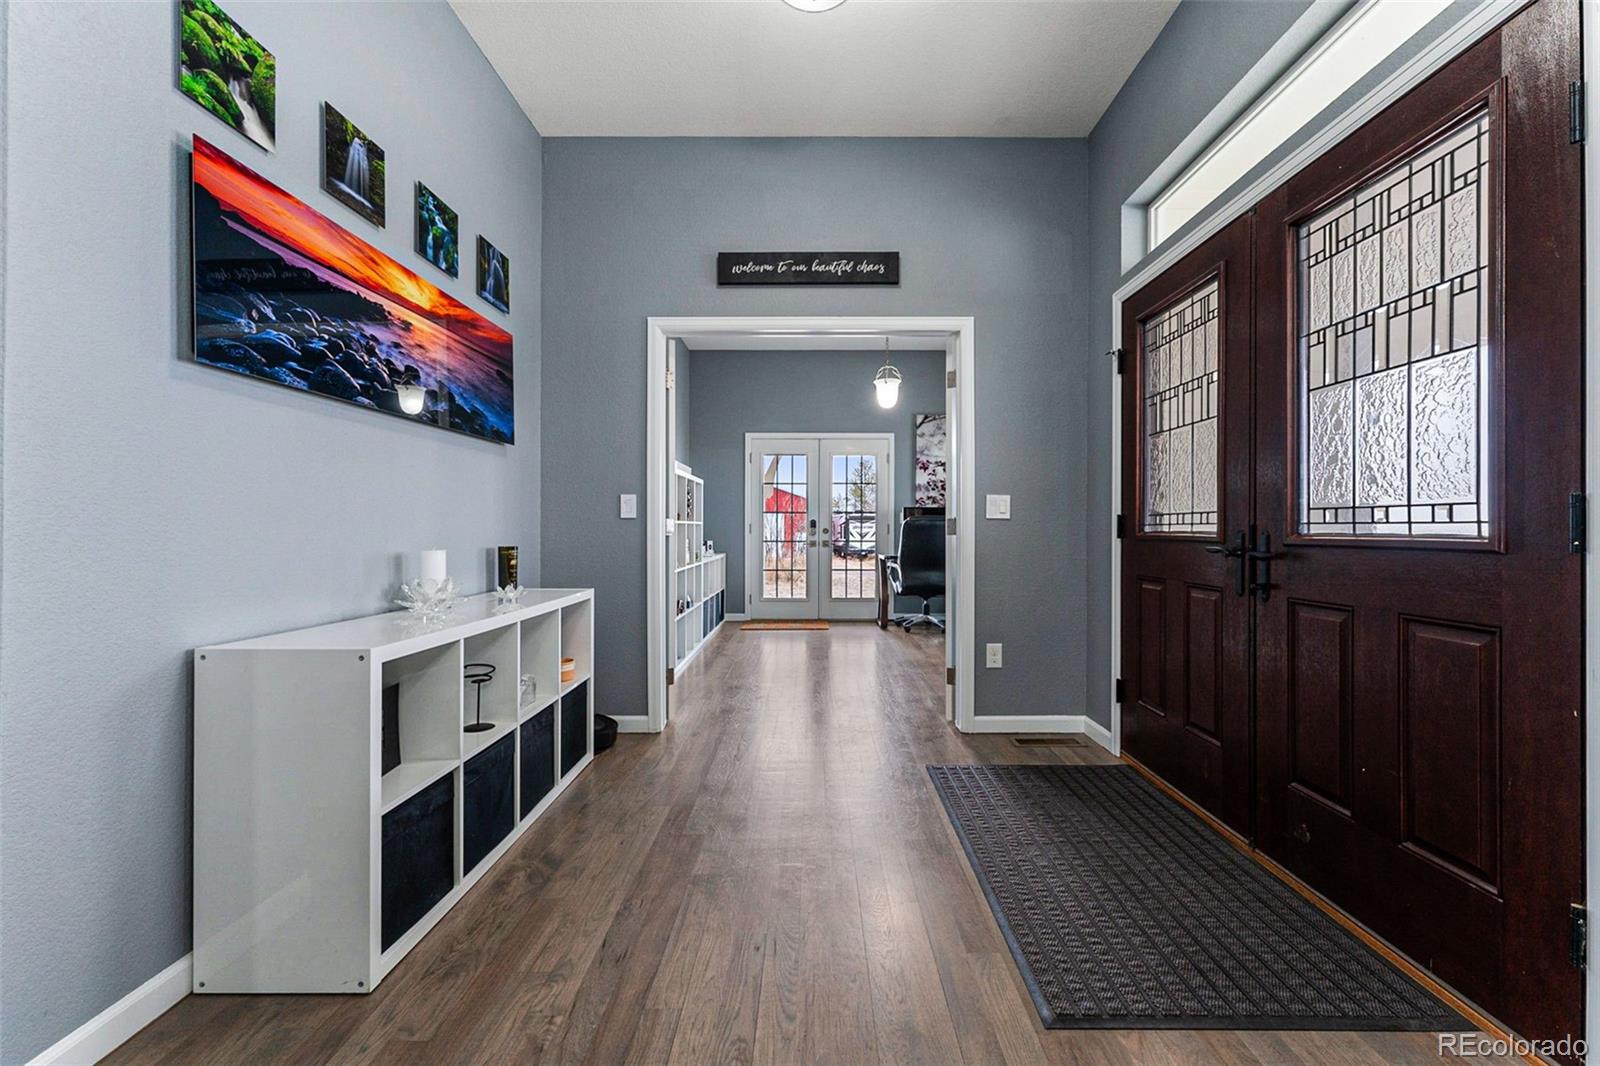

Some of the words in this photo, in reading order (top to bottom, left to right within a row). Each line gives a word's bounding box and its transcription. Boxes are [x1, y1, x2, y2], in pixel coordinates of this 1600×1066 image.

[732, 261, 775, 274] welcome
[777, 259, 795, 274] to
[791, 263, 809, 272] our
[811, 259, 854, 276] beautiful
[856, 259, 885, 274] chaos
